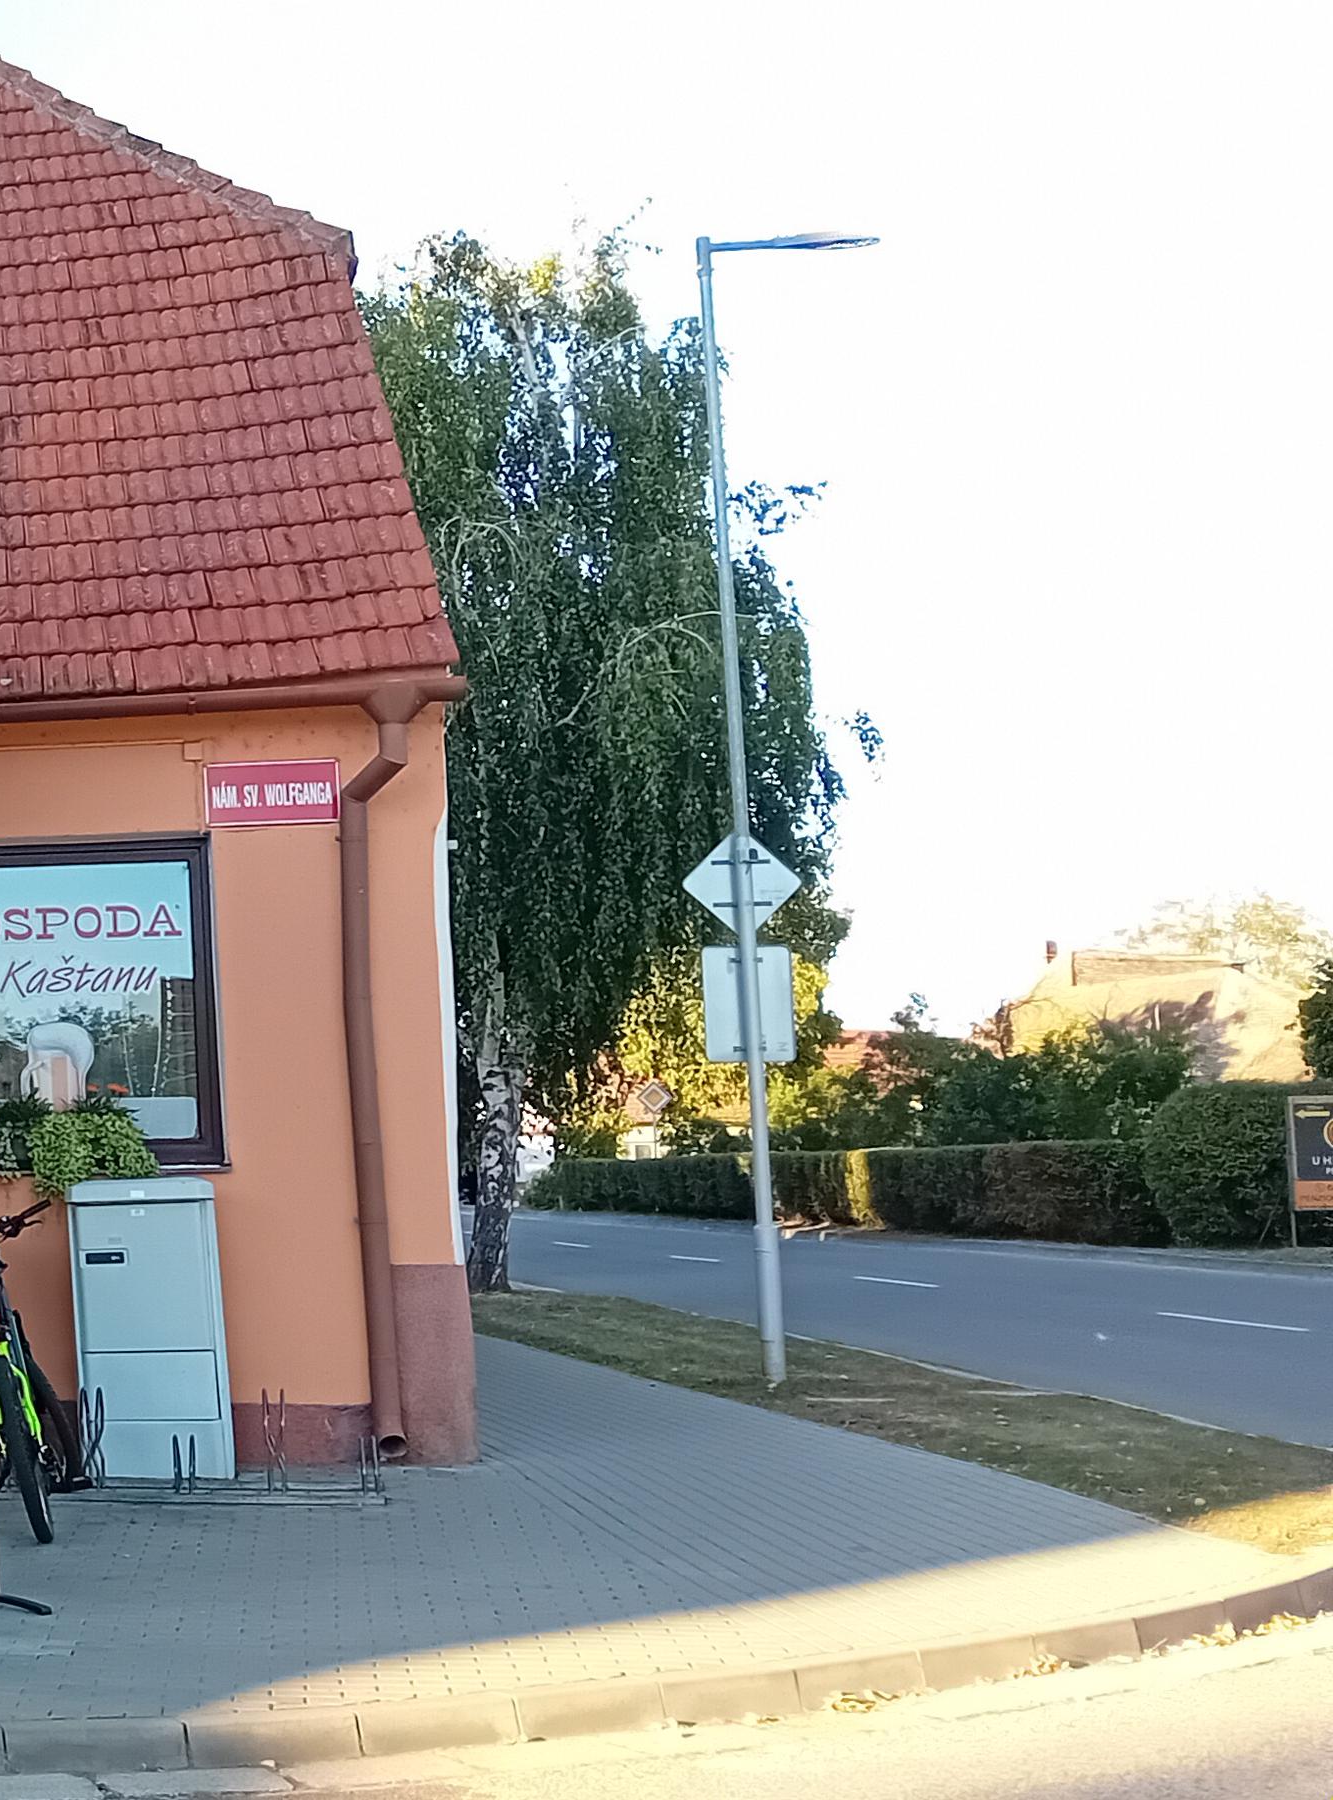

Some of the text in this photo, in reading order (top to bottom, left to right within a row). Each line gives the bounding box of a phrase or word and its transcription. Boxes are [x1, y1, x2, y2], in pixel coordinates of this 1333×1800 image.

[212, 781, 333, 809] NÁM. SV. WOLFGANGA
[0, 954, 158, 998] Kaštanu
